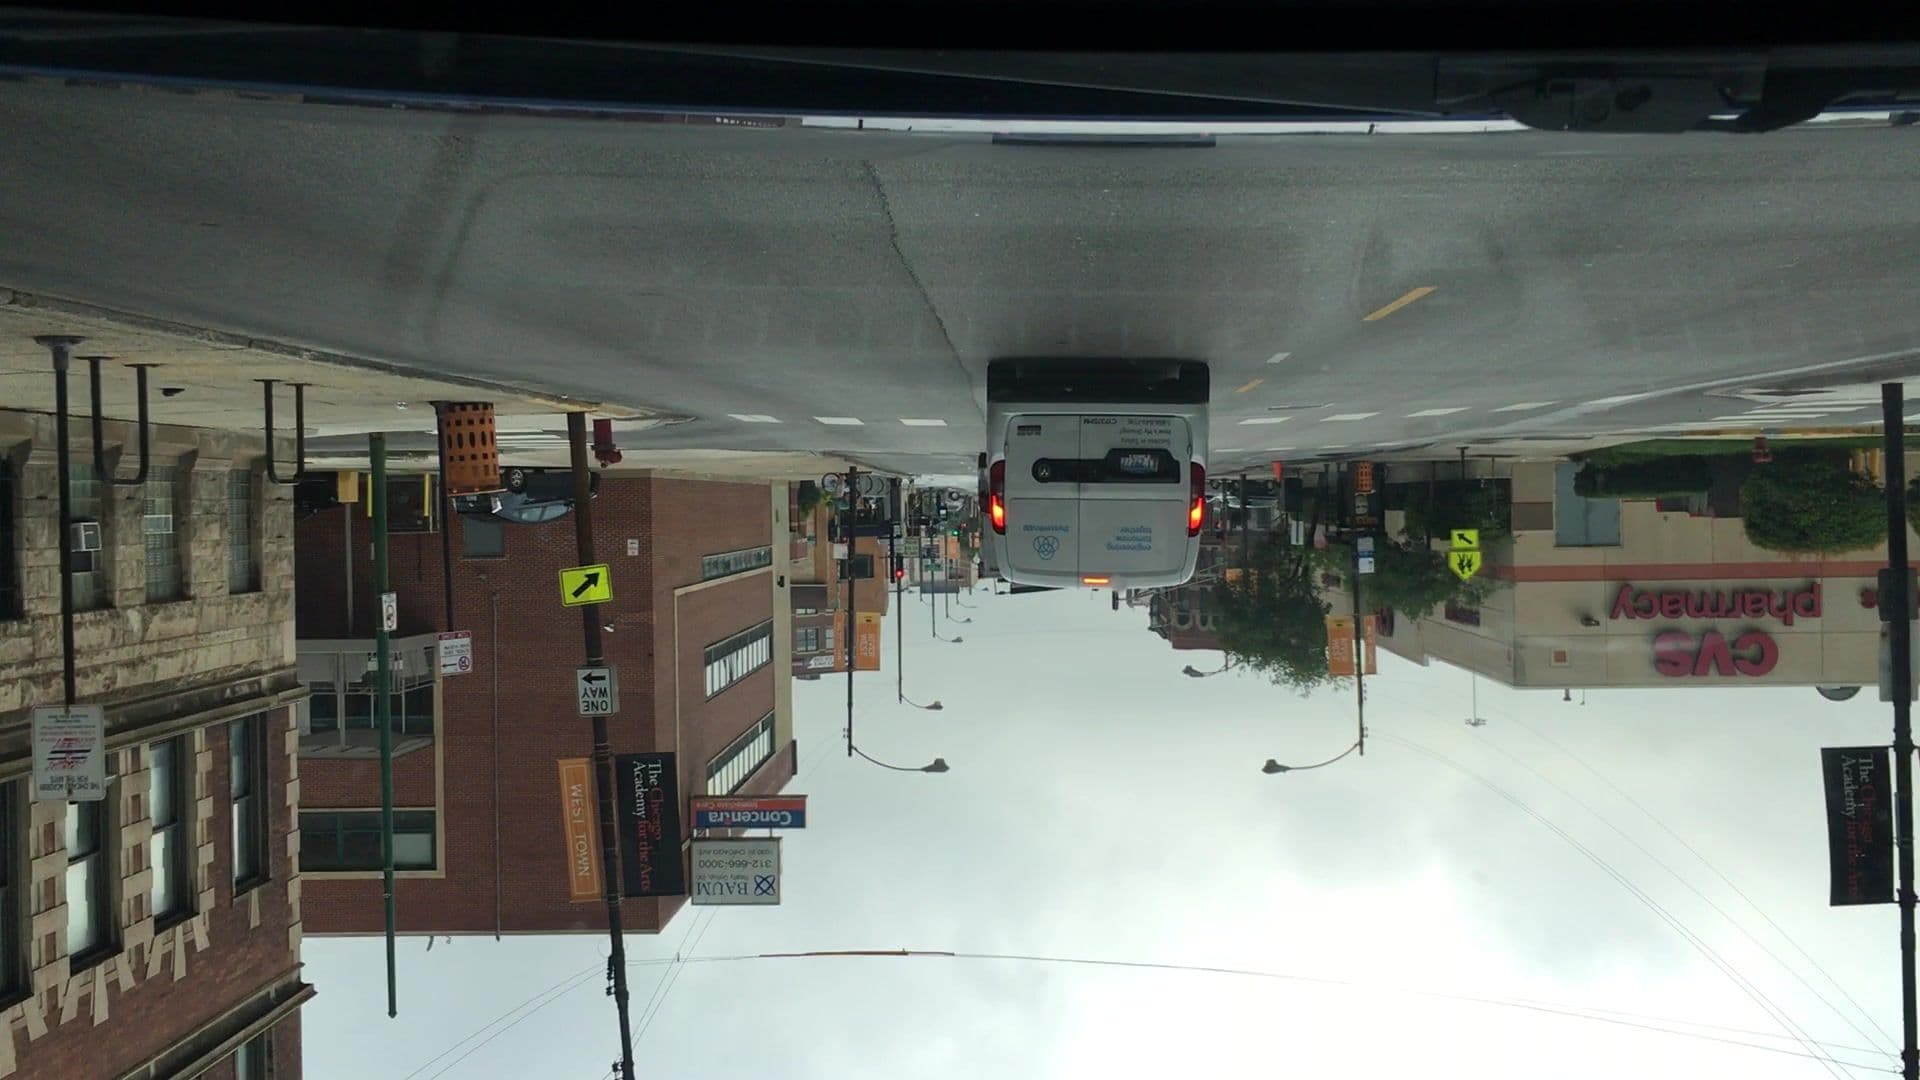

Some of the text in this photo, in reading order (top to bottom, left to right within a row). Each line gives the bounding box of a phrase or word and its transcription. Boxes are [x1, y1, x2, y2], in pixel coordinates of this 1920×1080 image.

[1609, 583, 1822, 626] pharmacy
[1653, 630, 1779, 678] CVS
[581, 686, 608, 699] WAY
[582, 700, 608, 712] ONE
[1840, 754, 1858, 818] Academy
[1858, 753, 1874, 783] The
[647, 759, 664, 840] The Chicago
[570, 783, 590, 876] WEST TOWN
[632, 760, 652, 892] Academy for the Arts
[708, 810, 792, 826] Concentra
[698, 860, 772, 868] 312-666-3000
[696, 882, 748, 896] BAUM
